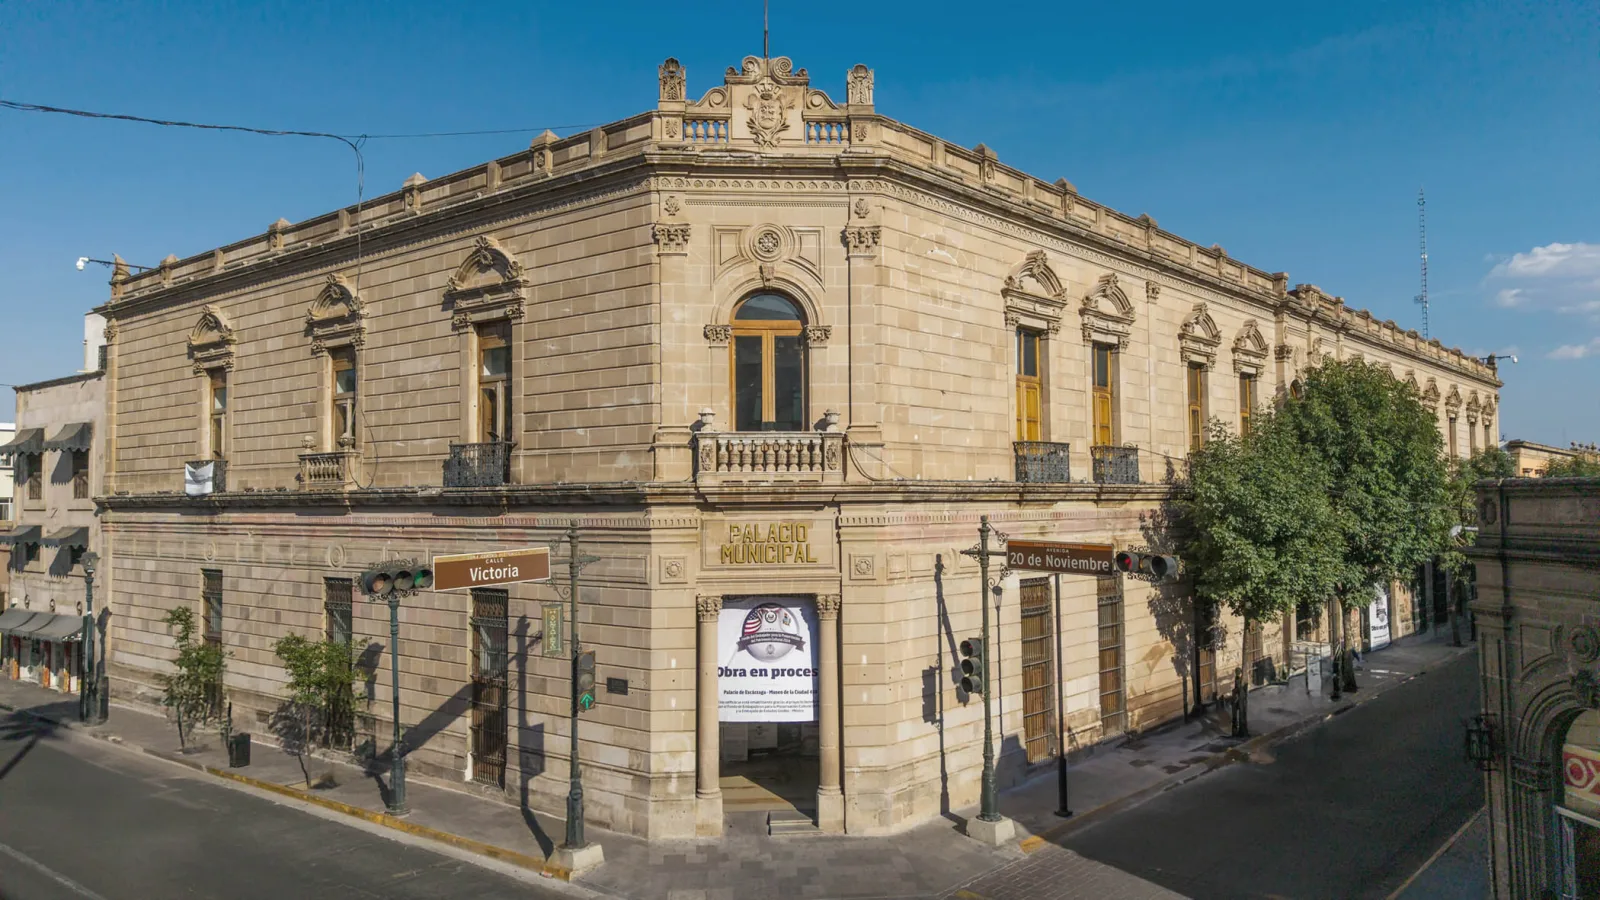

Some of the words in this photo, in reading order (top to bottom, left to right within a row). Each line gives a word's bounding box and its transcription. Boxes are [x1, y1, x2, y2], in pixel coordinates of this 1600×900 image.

[729, 523, 808, 543] PALACIO
[720, 543, 818, 564] MUNICIPAL
[1010, 552, 1024, 565] 20
[1027, 553, 1042, 567] de
[1045, 554, 1109, 571] Noviembre
[469, 564, 519, 582] Victoria
[750, 668, 768, 677] en
